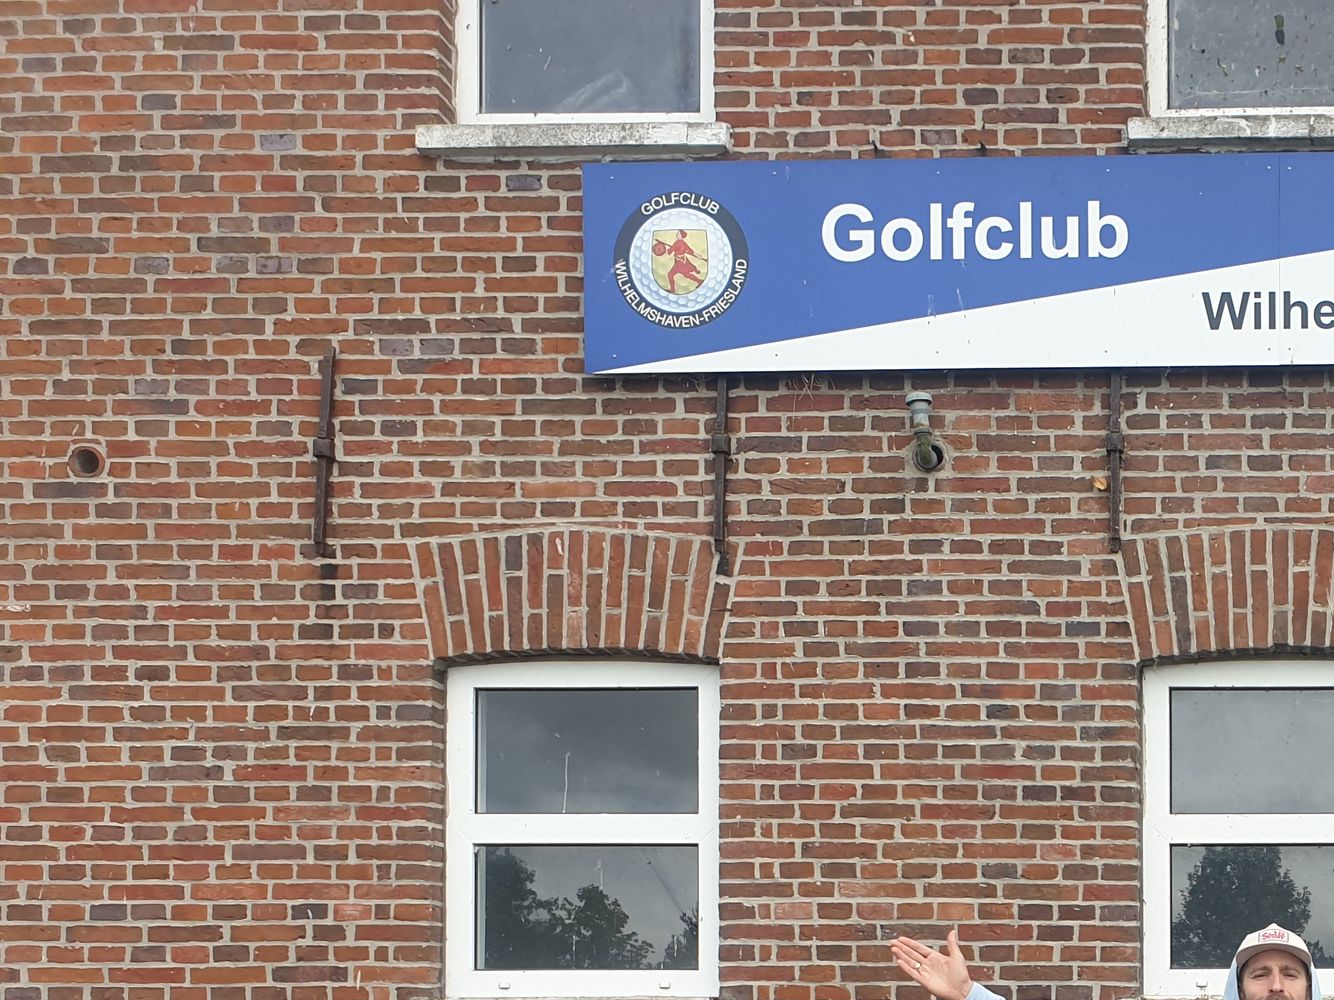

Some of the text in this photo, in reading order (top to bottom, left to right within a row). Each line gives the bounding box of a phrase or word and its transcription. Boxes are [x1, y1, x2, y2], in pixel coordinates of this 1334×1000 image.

[641, 192, 720, 215] GOLFCLUB
[822, 200, 1129, 262] Golfclub
[614, 258, 748, 328] WILHELMSHAVEN-FRIESLAND
